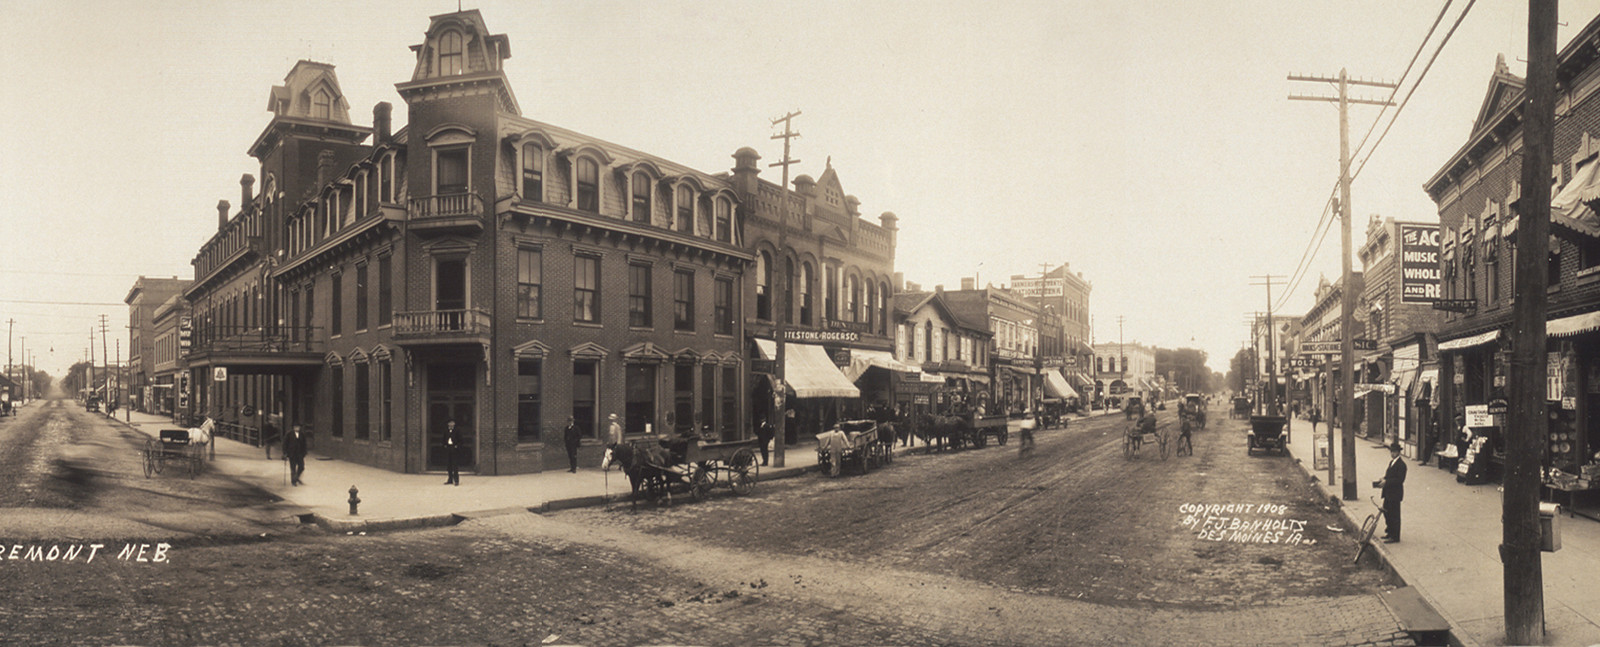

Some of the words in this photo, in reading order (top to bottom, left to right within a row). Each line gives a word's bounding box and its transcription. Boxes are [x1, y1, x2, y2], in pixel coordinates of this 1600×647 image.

[1404, 231, 1418, 243] THE
[1418, 230, 1441, 247] AC
[1404, 251, 1438, 264] MUSIC
[1404, 286, 1425, 295] AND
